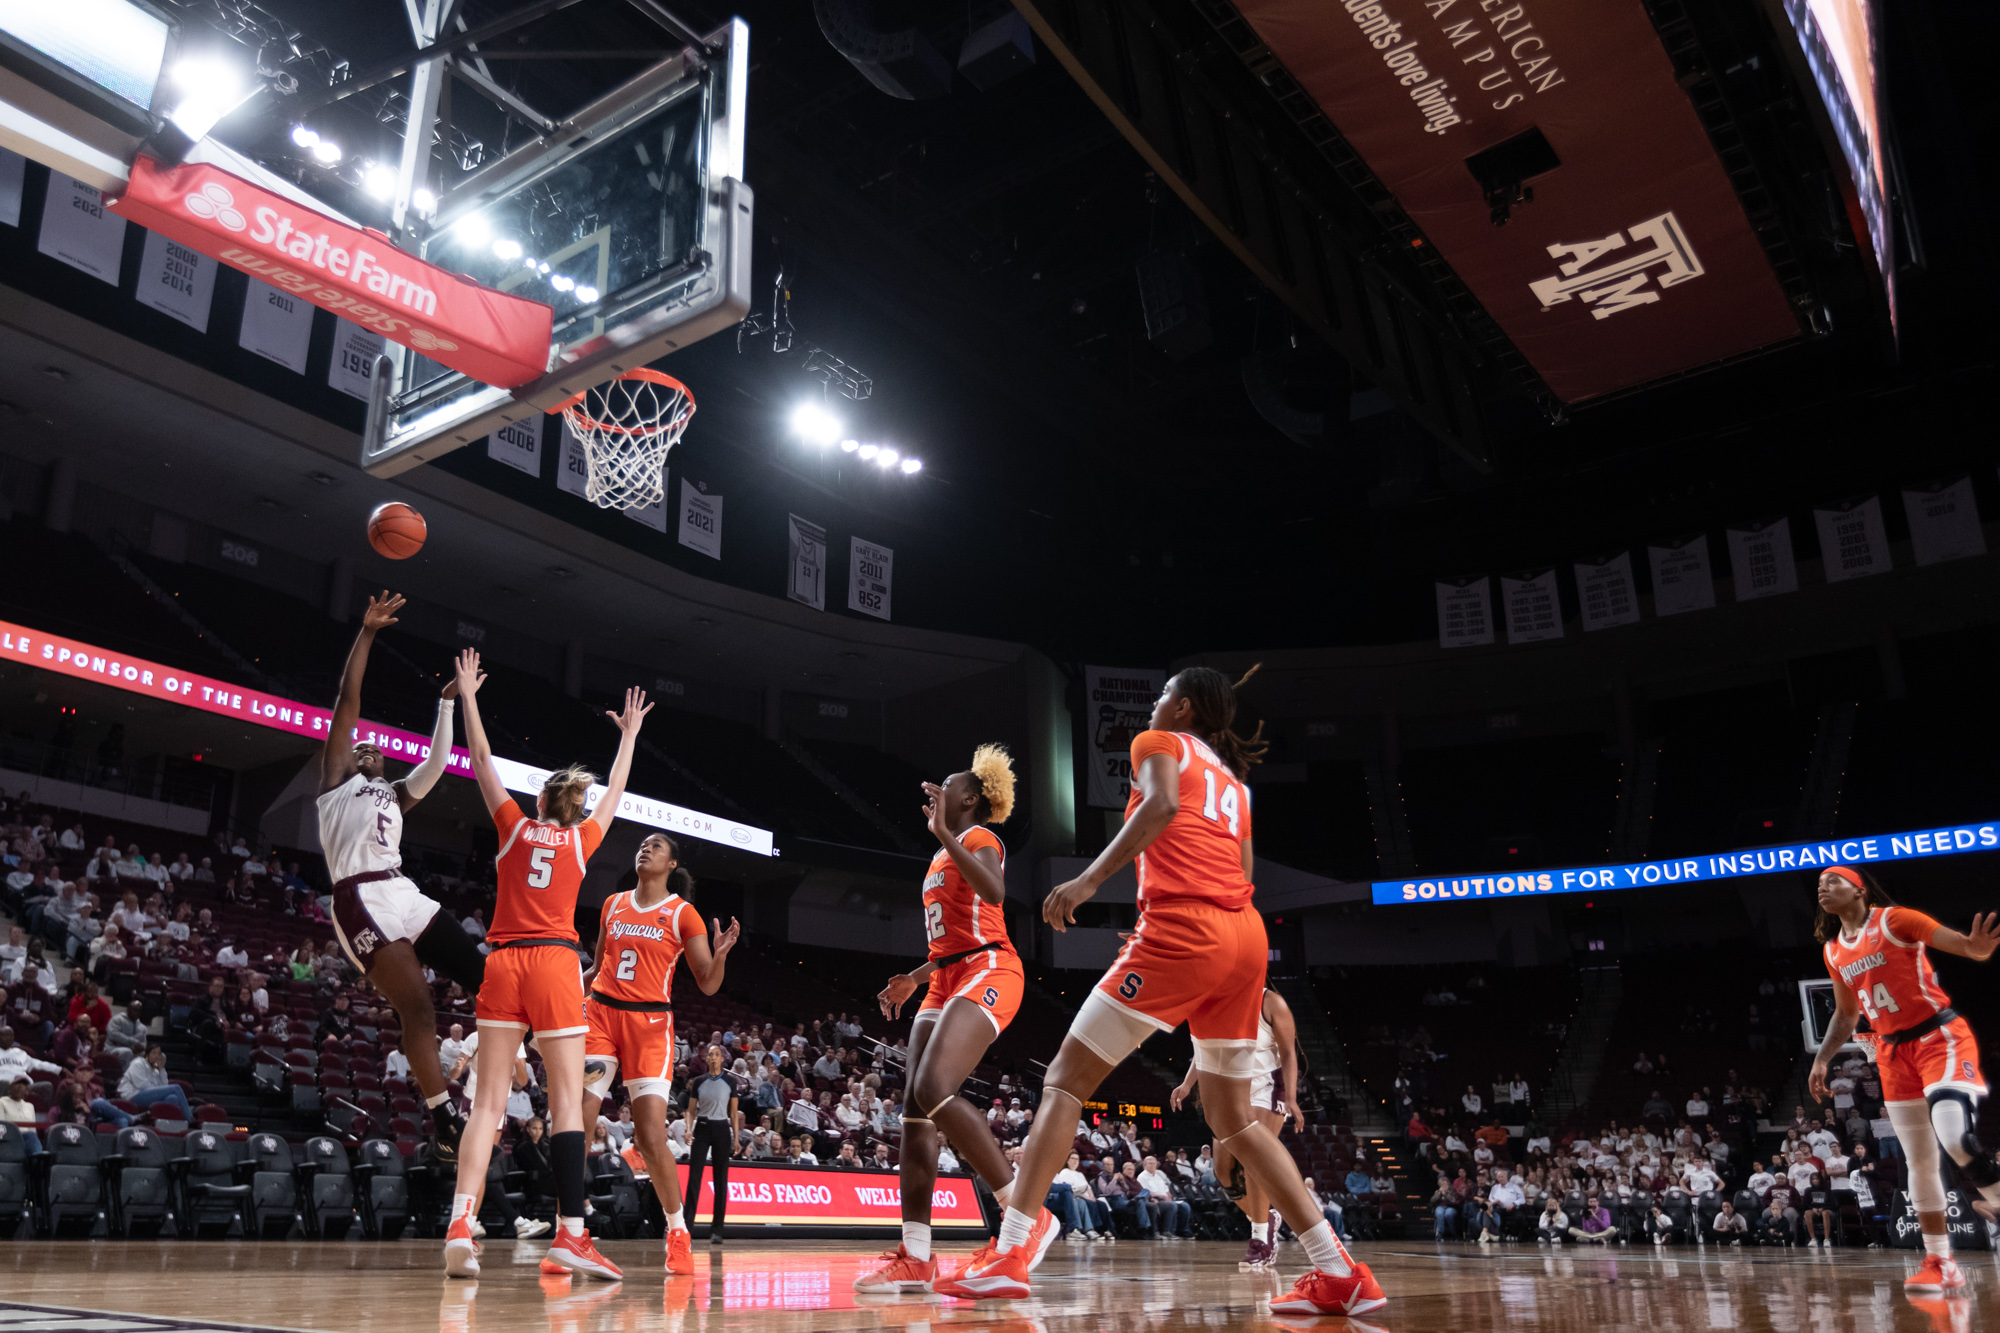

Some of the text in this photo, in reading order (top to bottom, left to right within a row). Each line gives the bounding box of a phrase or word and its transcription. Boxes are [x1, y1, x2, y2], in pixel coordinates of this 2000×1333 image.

[1340, 0, 1461, 136] dents love living.
[73, 195, 103, 219] 2021
[166, 242, 198, 267] 2008
[166, 257, 194, 281] 2011
[162, 271, 193, 297] 2014
[268, 292, 294, 313] 2011
[342, 350, 371, 379] 199
[498, 426, 535, 453] 2008
[569, 455, 586, 477] 20
[687, 508, 714, 534] 2021
[222, 541, 258, 566] 206
[1840, 543, 1869, 558] 2003
[1841, 555, 1872, 569] 2009
[859, 560, 883, 580] 2011
[1752, 574, 1777, 588] 1997
[858, 590, 881, 610] 852
[457, 622, 486, 641] 207
[656, 679, 684, 695] 208
[1100, 677, 1152, 692] NATIONAL
[3, 633, 471, 769] LE SPONSOR OF THE LONE STR SHOWDWN
[1092, 690, 1159, 705] CHAMPIONS
[819, 703, 848, 718] 209
[1114, 711, 1151, 728] FINA
[1107, 758, 1131, 778] 20
[355, 784, 399, 810] Aggi
[1202, 767, 1240, 837] 14
[375, 811, 392, 847] 5
[524, 825, 570, 846] WOOLLEY
[527, 846, 556, 889] 5
[1402, 826, 1997, 901] SOLUTIONS FOR YOUR INSURANCE NEEDS
[609, 919, 665, 942] Syracuse
[616, 949, 638, 981] 2
[982, 987, 999, 1007] S
[1118, 971, 1143, 1000] S
[1857, 982, 1900, 1020] 24
[773, 1183, 832, 1205] FARGO
[1896, 1219, 1975, 1236] OPPUNE
